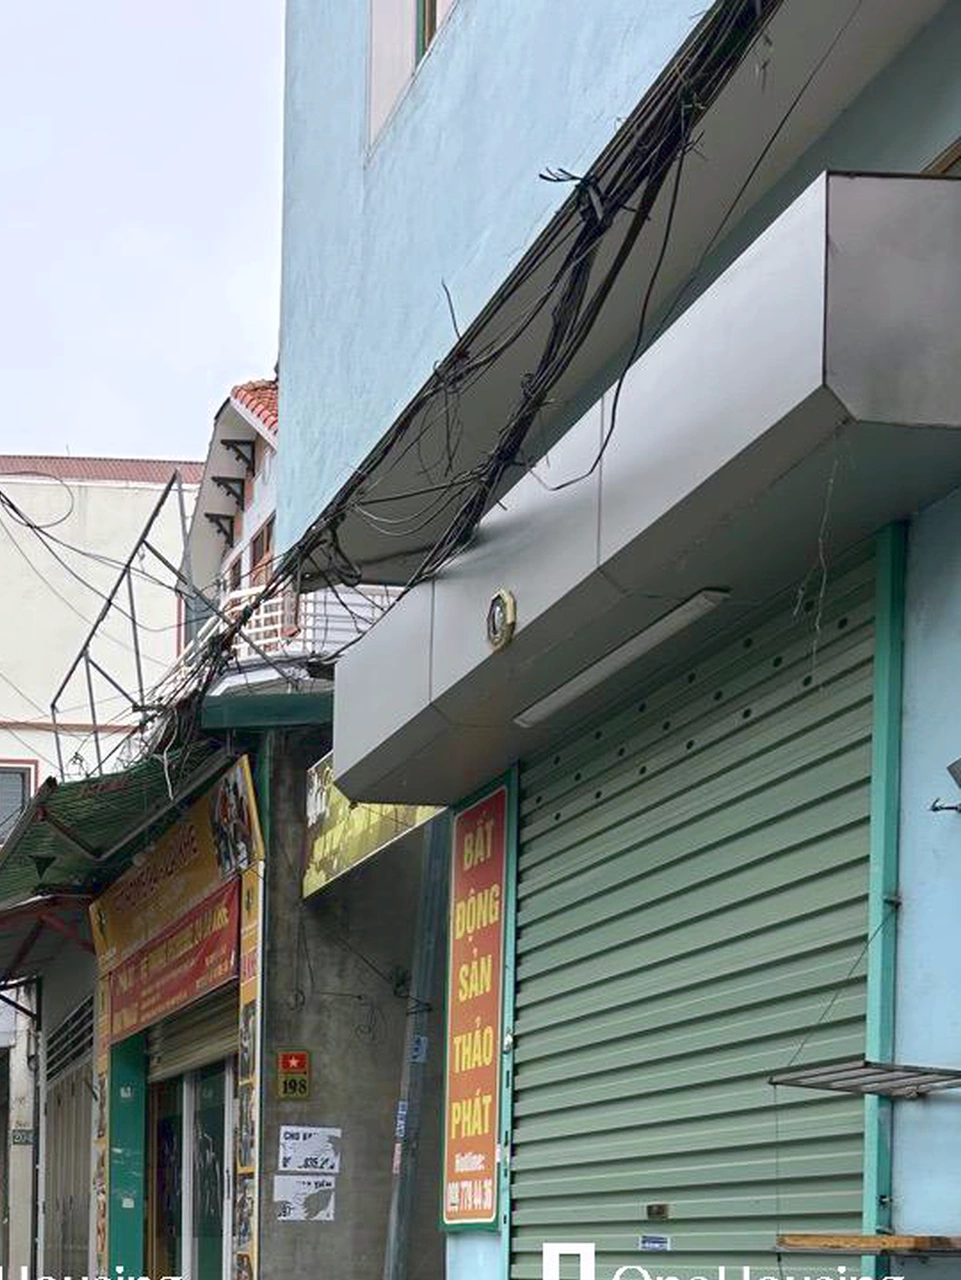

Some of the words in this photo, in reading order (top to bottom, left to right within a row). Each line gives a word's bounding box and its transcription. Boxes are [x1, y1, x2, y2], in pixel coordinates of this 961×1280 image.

[463, 815, 495, 871] BẤT
[455, 887, 500, 944] ĐỘNG
[459, 948, 492, 1002] SẢN
[453, 1018, 493, 1074] THẢO
[283, 1078, 307, 1096] 198
[451, 1088, 492, 1140] PHÁT
